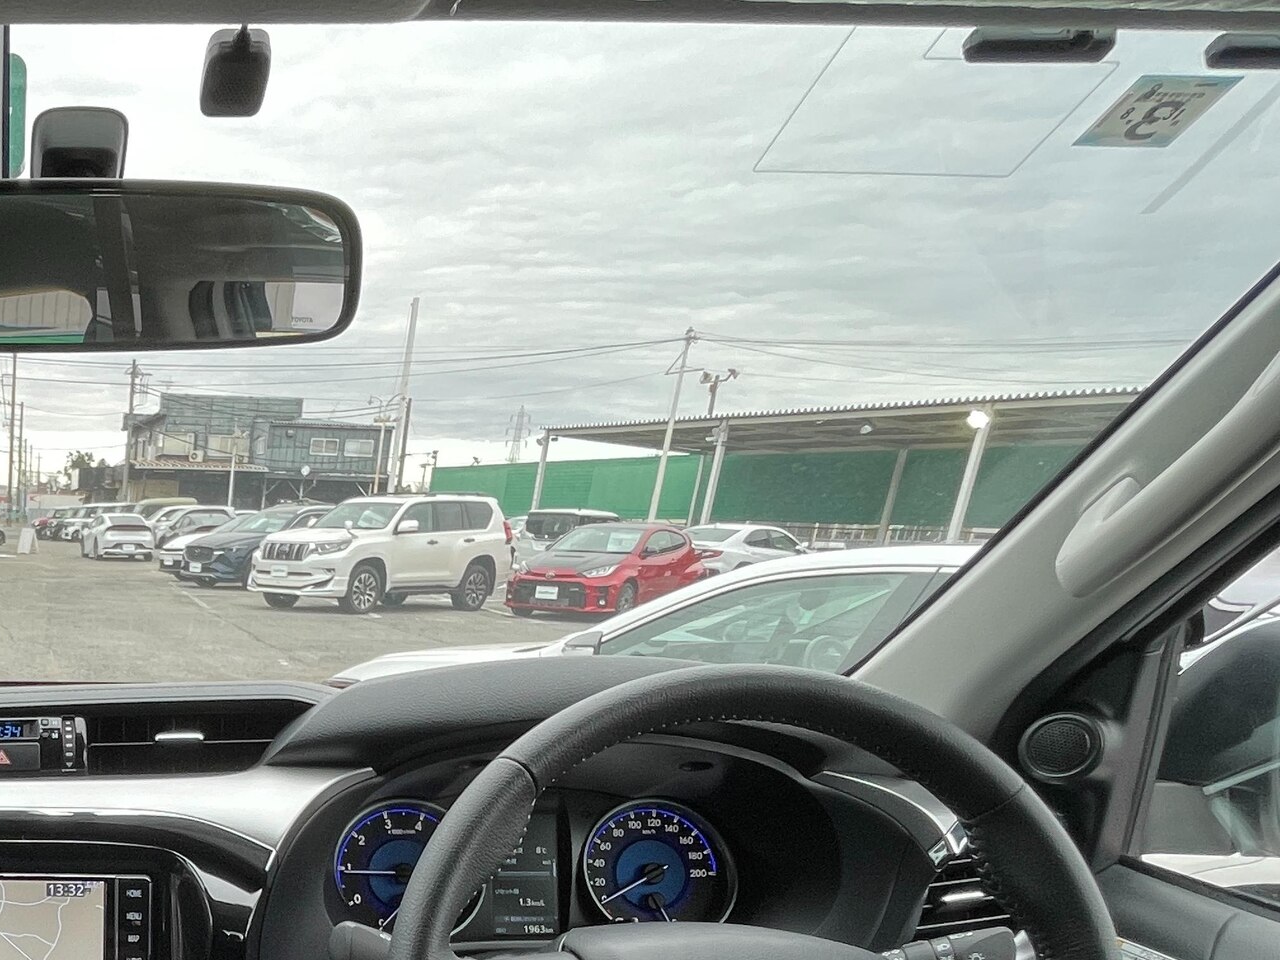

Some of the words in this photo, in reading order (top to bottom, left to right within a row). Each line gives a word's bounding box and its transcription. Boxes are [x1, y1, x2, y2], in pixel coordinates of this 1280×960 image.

[385, 819, 392, 830] 3
[415, 820, 423, 832] 4
[628, 820, 642, 830] 100
[647, 819, 662, 827] 120
[612, 828, 625, 838] 80
[665, 824, 680, 833] 140
[358, 835, 366, 846] 2
[680, 836, 694, 845] 160
[600, 842, 612, 851] 60
[688, 851, 703, 861] 180
[593, 858, 606, 868] 40
[690, 869, 708, 878] 200
[594, 877, 606, 887] 20
[48, 884, 84, 897] 13:32
[126, 890, 142, 898] HOME
[353, 893, 362, 905] 0
[127, 934, 140, 943] MAP
